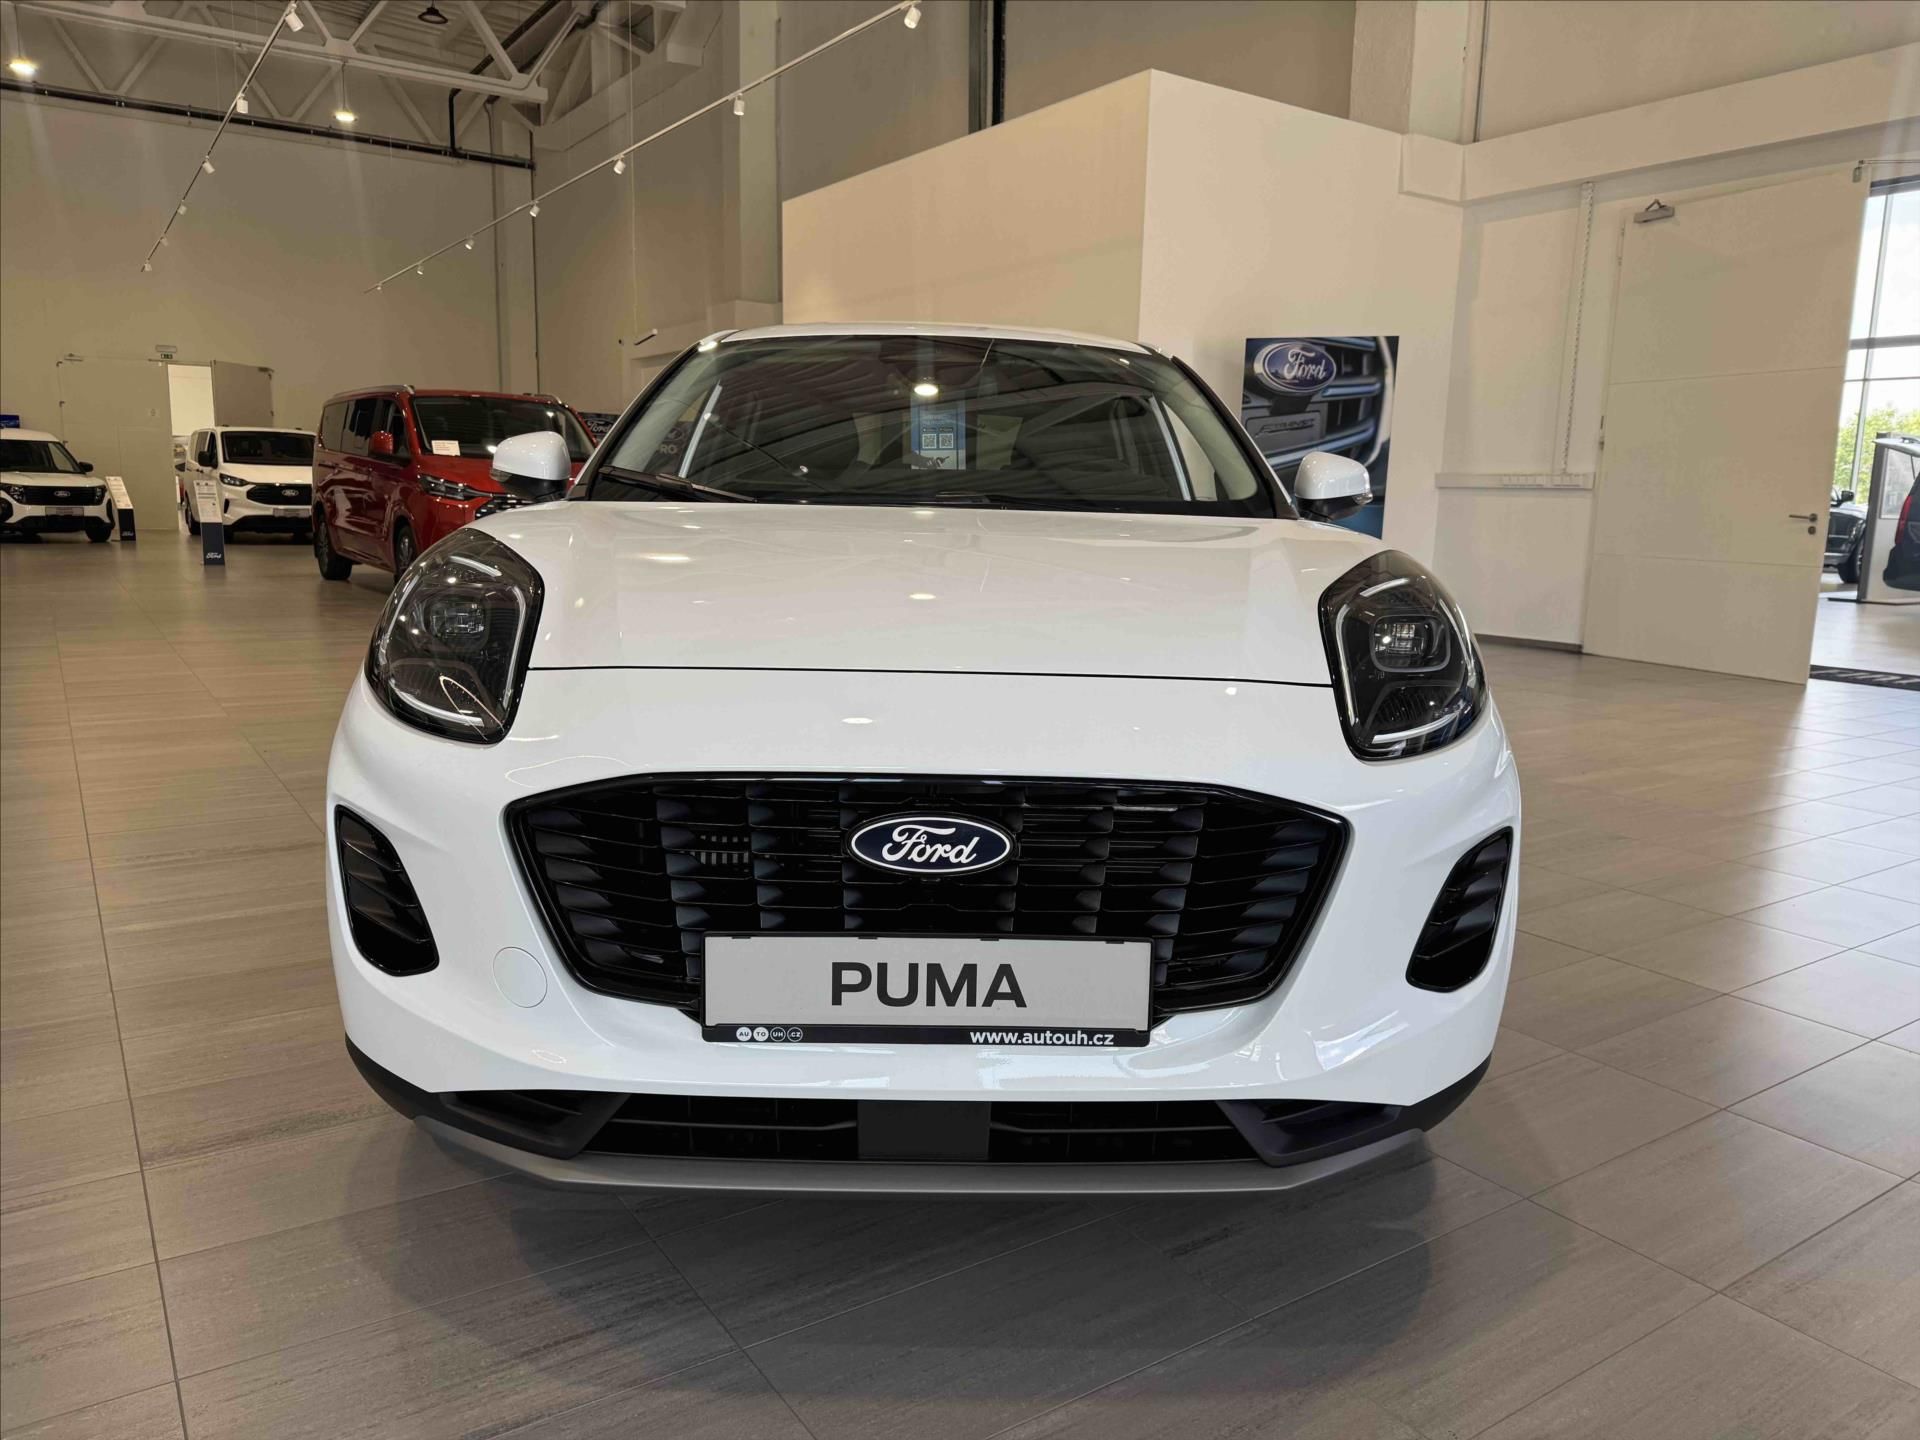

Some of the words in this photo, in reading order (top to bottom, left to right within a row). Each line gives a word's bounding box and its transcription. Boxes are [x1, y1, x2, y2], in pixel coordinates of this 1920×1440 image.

[1283, 348, 1327, 380] Ford
[658, 444, 678, 454] RO
[881, 824, 980, 864] Ford
[831, 961, 1028, 1008] PUMA
[969, 1030, 1114, 1045] www.autouh.cz
